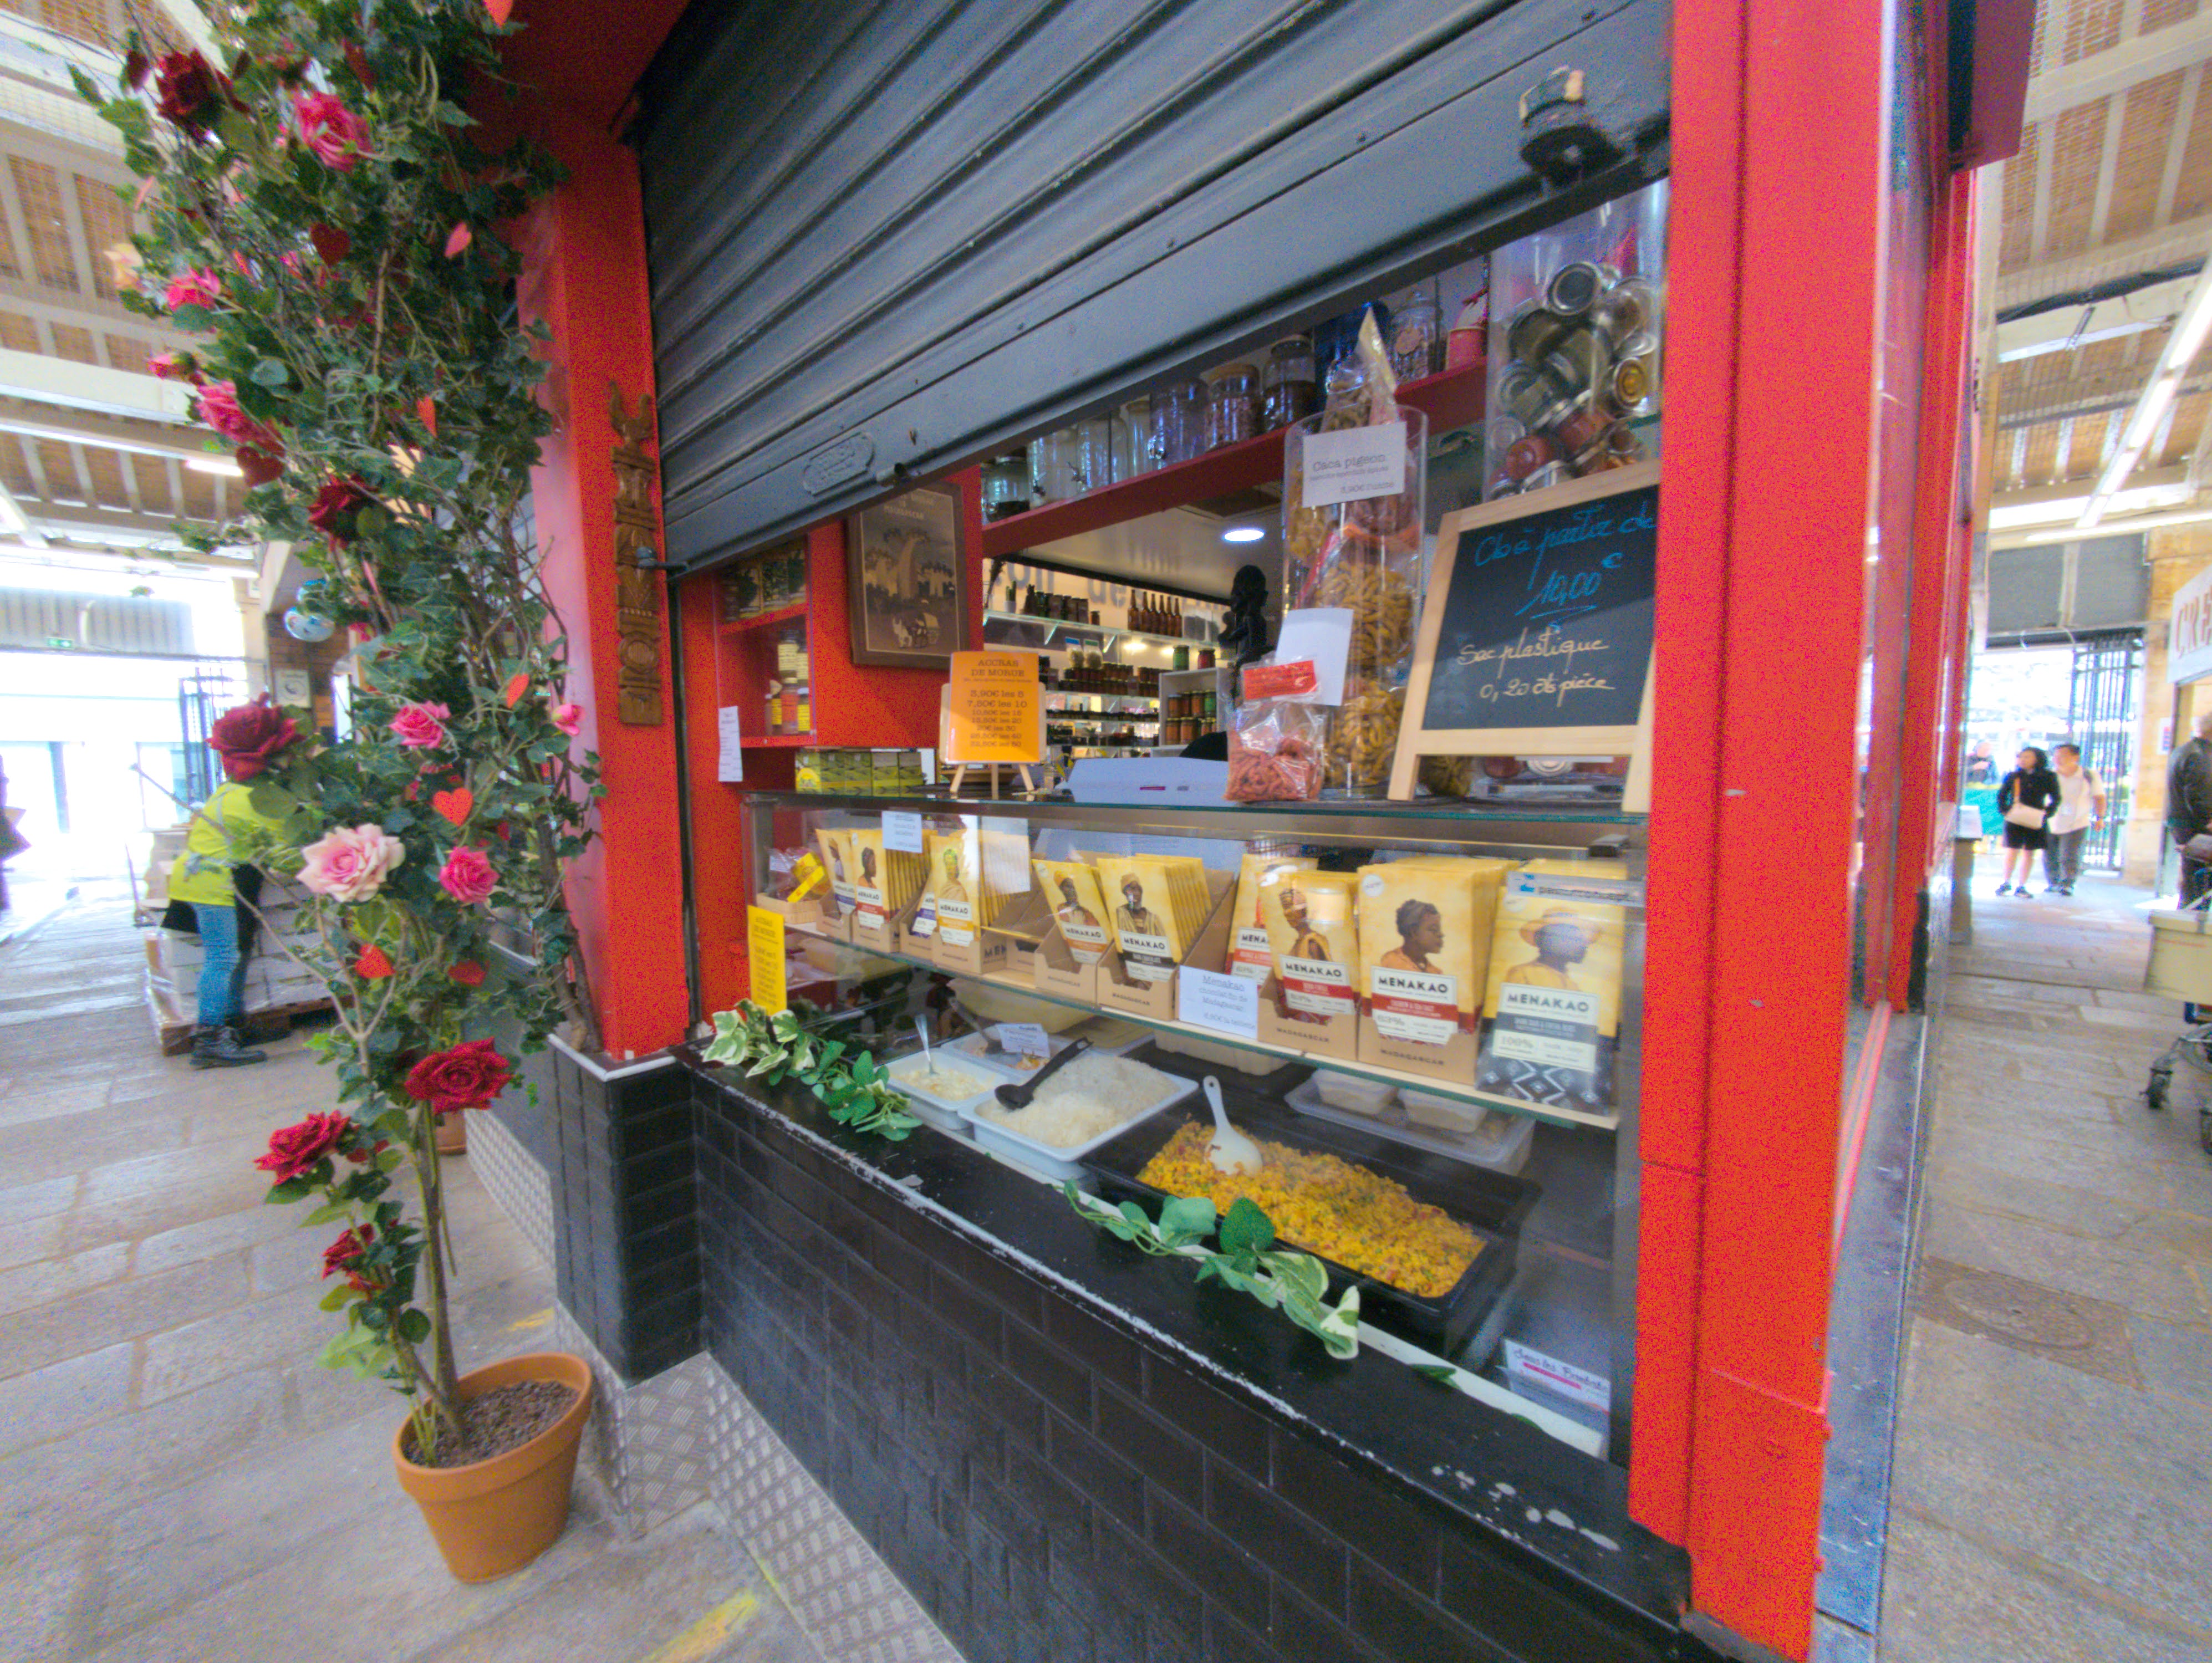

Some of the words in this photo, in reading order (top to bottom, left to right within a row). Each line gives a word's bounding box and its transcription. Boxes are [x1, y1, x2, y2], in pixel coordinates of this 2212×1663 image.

[1312, 460, 1342, 472] Caca
[1344, 454, 1387, 470] pigeon
[1457, 644, 1496, 666] Sac
[1497, 626, 1610, 680] plastique
[978, 659, 1019, 667] ACCRAS
[988, 669, 1025, 677] MORUE
[1015, 700, 1027, 708] 10
[939, 904, 970, 915] MENAKAO
[1065, 927, 1102, 938] MENAKAO
[1241, 933, 1268, 943] MENA
[1122, 936, 1166, 951] MENAKAO
[1285, 962, 1343, 978] MENAKAO
[1202, 975, 1245, 992] Menakao
[1378, 976, 1449, 994] MENAKAO
[1506, 993, 1590, 1013] MENAKAO
[1276, 1027, 1331, 1044] MADAGASCAR
[1380, 1048, 1445, 1065] MADAGASCAR
